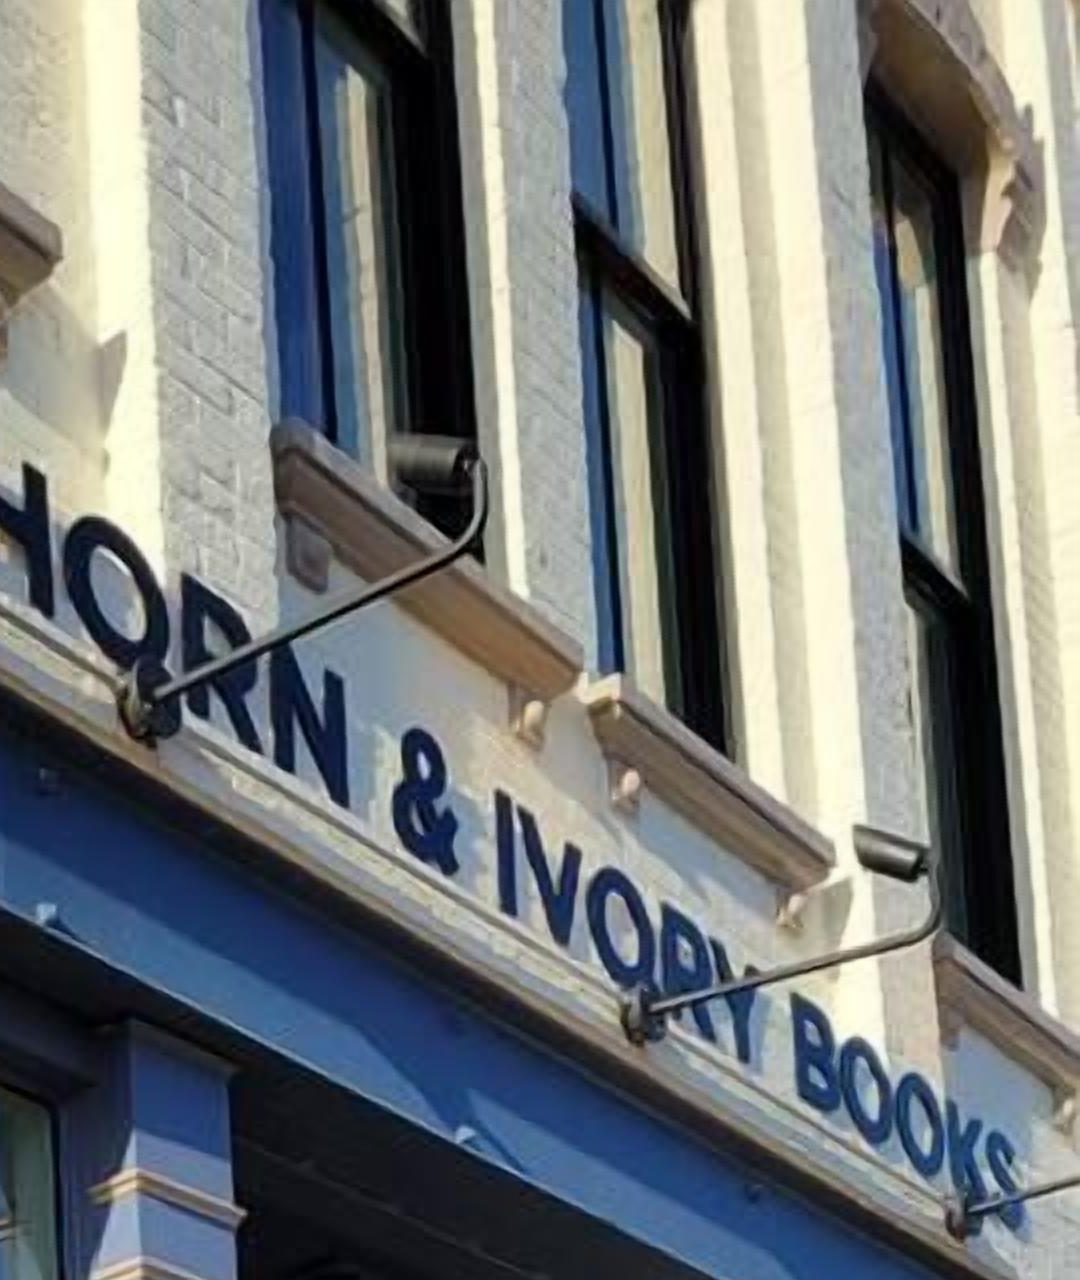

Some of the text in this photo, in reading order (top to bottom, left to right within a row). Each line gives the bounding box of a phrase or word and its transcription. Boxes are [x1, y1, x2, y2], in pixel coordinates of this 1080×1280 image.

[392, 728, 459, 876] &
[494, 788, 762, 1064] IVORY
[790, 992, 1030, 1238] BOOKS
